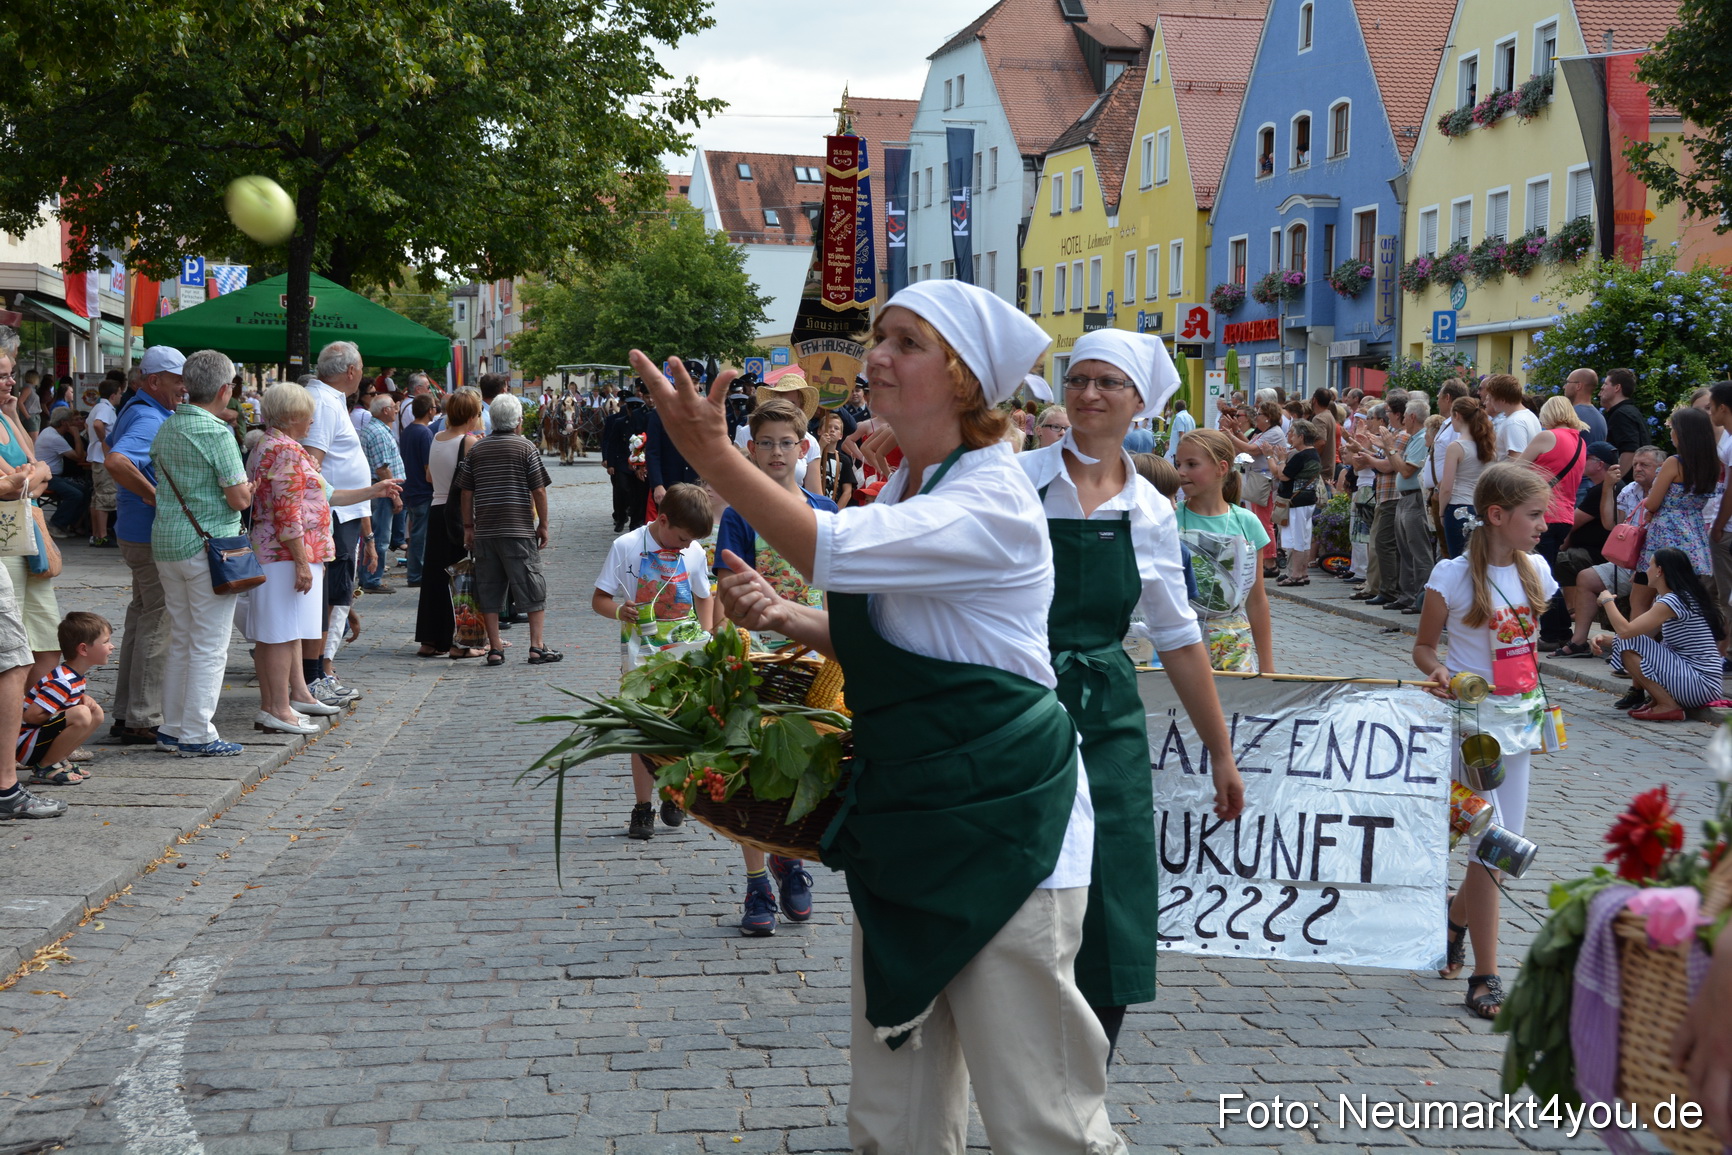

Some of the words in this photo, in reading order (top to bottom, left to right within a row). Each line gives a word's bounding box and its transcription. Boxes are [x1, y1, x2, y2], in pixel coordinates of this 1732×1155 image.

[1061, 235, 1082, 256] HOTEL
[185, 259, 199, 282] P
[1222, 318, 1278, 344] APOTHEKE
[1438, 315, 1451, 340] P
[801, 340, 865, 359] FFW-HAUSHEIM
[1153, 810, 1395, 884] UKUNFT
